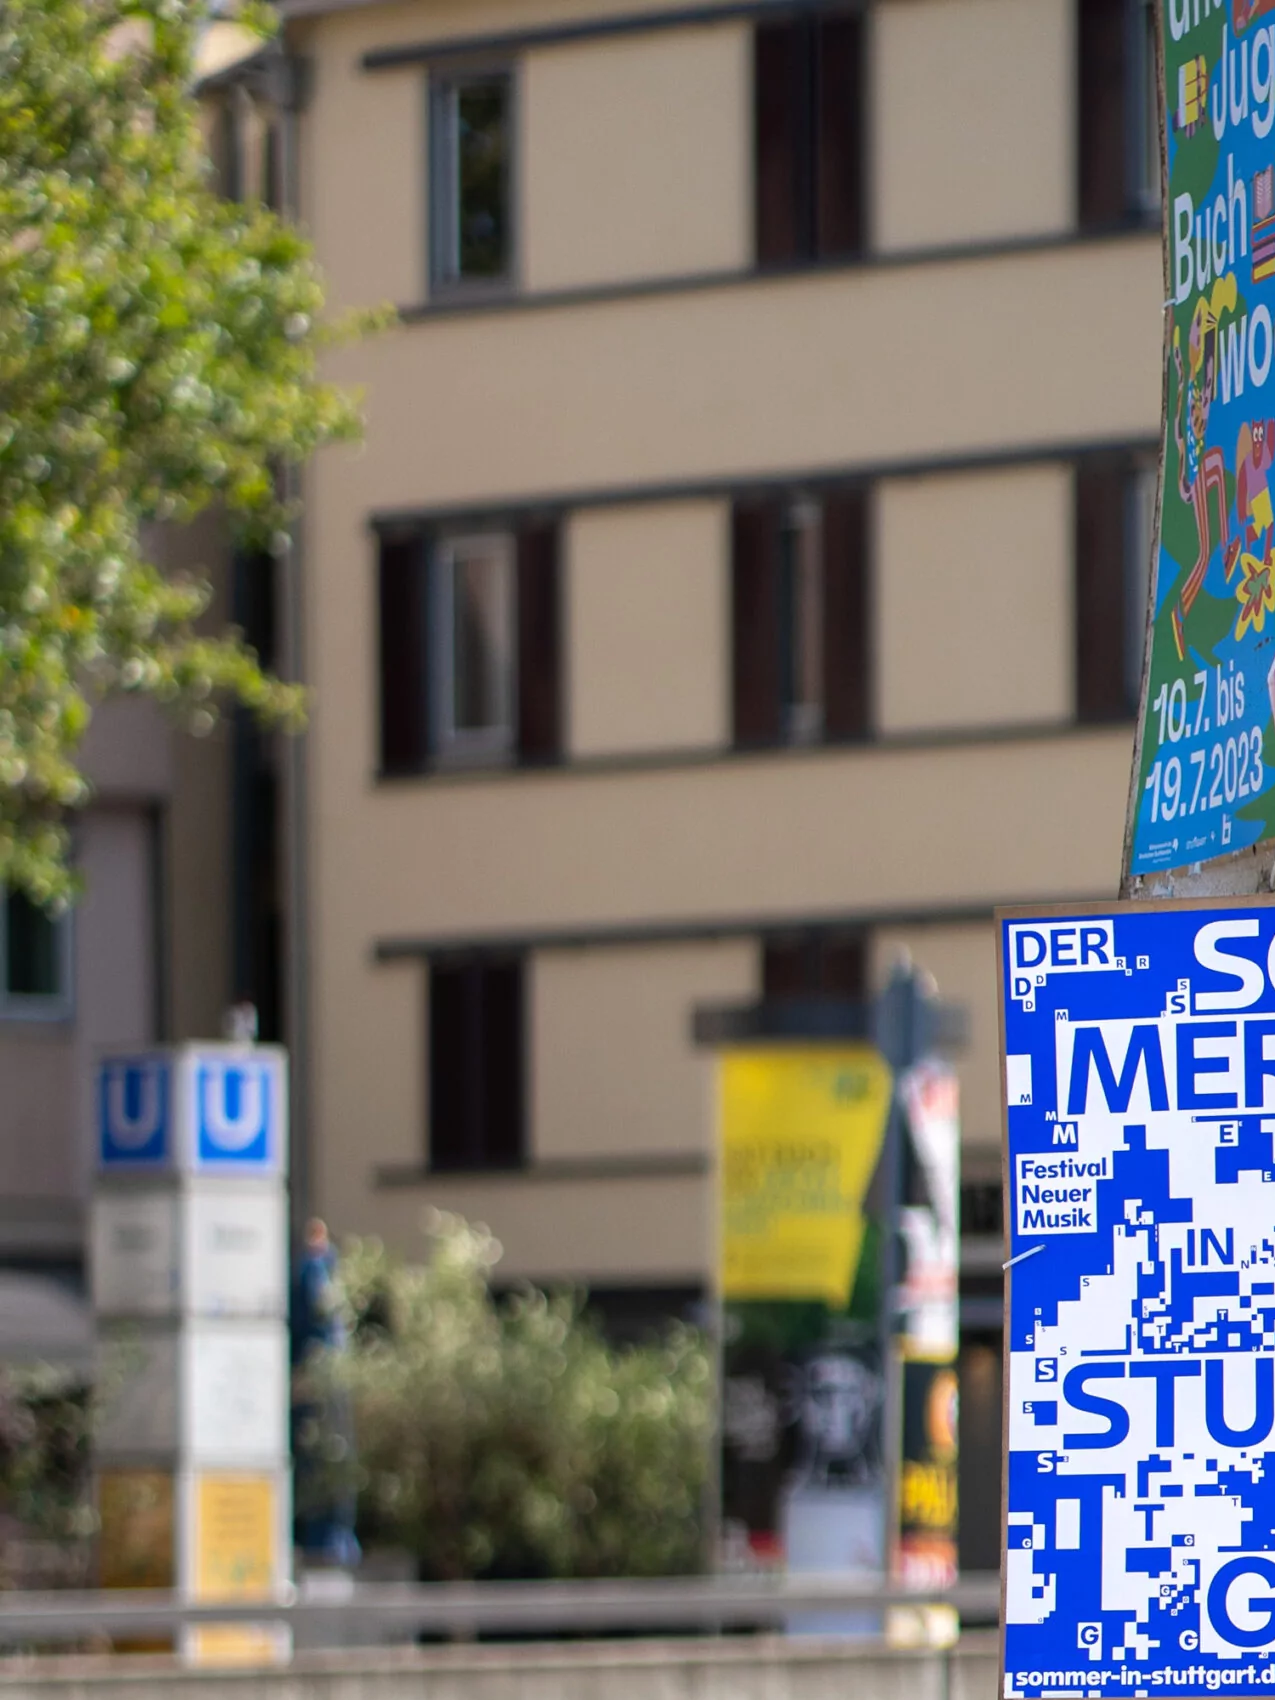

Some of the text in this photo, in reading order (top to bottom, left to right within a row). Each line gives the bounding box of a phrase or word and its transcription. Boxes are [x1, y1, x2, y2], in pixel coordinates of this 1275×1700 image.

[1173, 153, 1247, 305] Buch
[1153, 660, 1245, 745] 10.7. bis
[1146, 725, 1263, 823] 19.7.2023
[1015, 928, 1109, 968] DER
[1015, 977, 1031, 996] D
[1170, 995, 1186, 1014] S
[108, 1060, 159, 1149] U
[205, 1061, 261, 1151] U
[1052, 1124, 1076, 1144] M
[1220, 1124, 1234, 1143] E
[1021, 1157, 1106, 1179] Festival
[1022, 1185, 1092, 1204] Neuer
[1022, 1208, 1092, 1229] Musik
[1187, 1227, 1234, 1266] IN
[1063, 1357, 1274, 1450] STU
[1037, 1452, 1054, 1473] S
[1081, 1626, 1099, 1645] G
[1179, 1630, 1199, 1650] G
